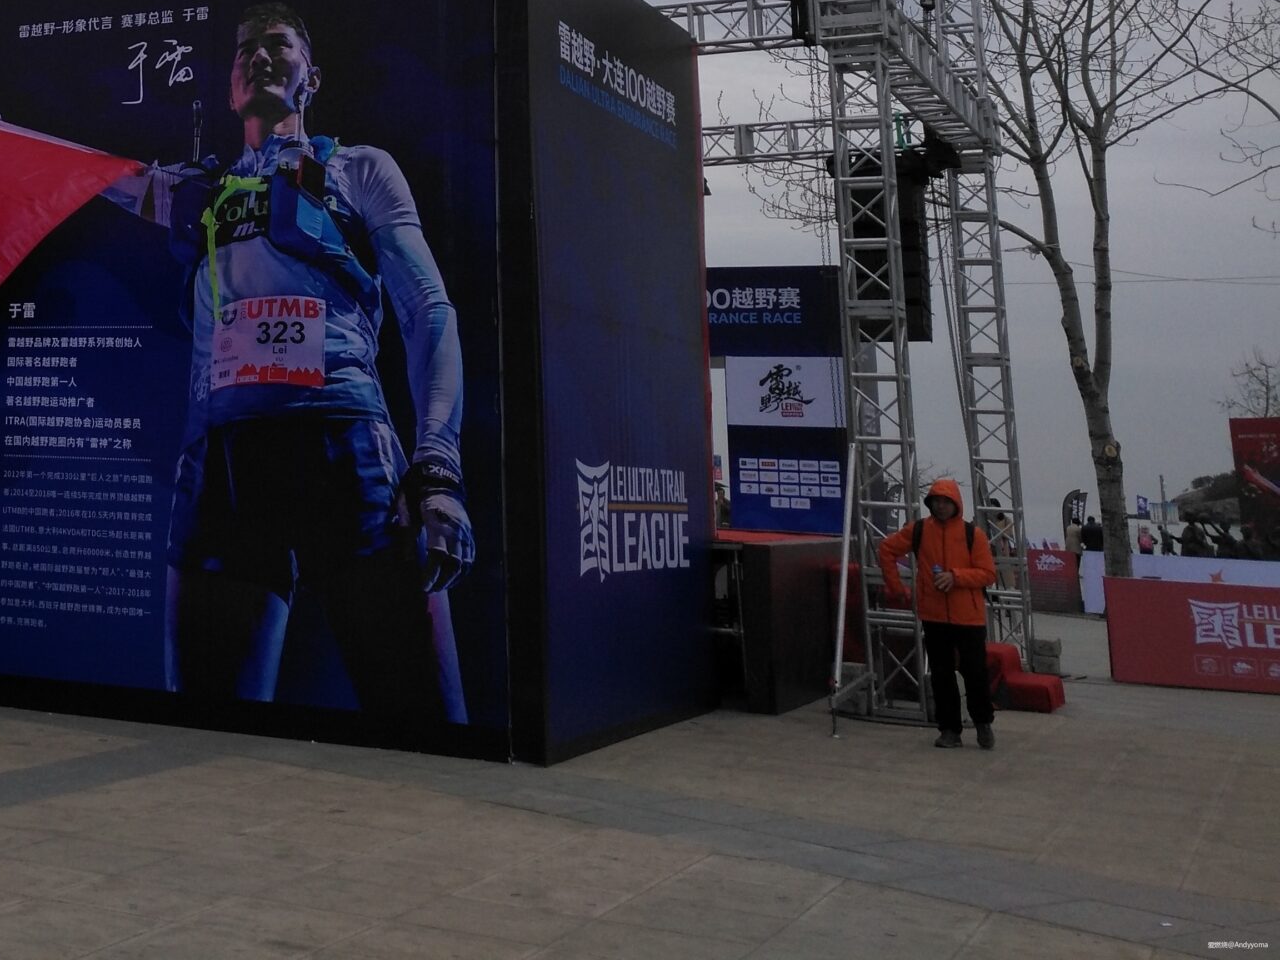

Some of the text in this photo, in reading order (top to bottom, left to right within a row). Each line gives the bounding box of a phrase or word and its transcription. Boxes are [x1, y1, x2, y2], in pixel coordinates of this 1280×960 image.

[121, 10, 174, 28] 赛事总监
[182, 6, 209, 23] 于雷
[8, 302, 36, 319] 于雷
[247, 298, 320, 319] UTMB
[763, 312, 802, 324] RACE
[256, 321, 306, 344] 323
[272, 345, 287, 354] Lei
[6, 376, 77, 387] 中国越野跑第一人
[610, 465, 688, 503] LEI ULTRA TRAIL
[611, 512, 691, 572] LEAGUE
[1242, 603, 1270, 620] LEI
